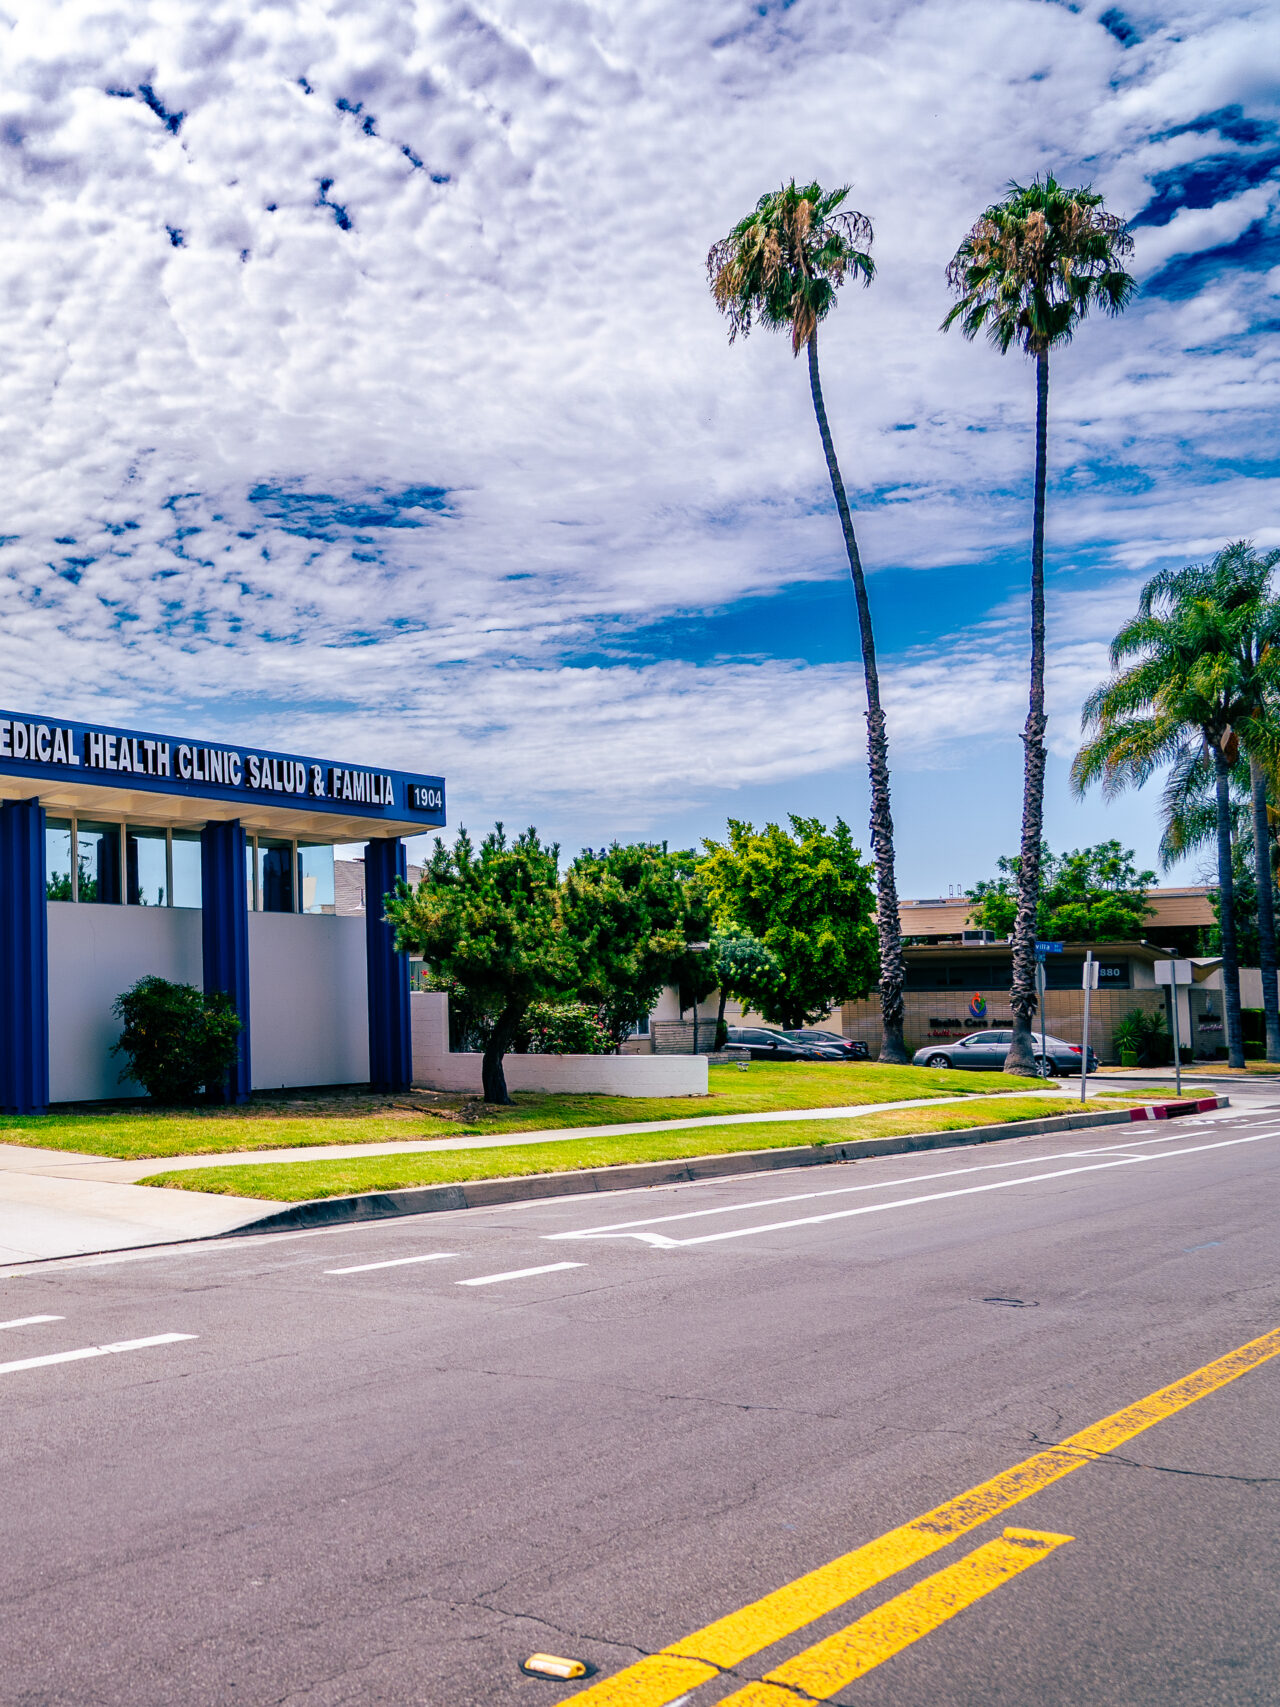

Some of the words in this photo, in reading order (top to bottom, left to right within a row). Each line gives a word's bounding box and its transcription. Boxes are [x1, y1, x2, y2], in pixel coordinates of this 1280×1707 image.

[89, 731, 170, 777] HEALTH
[178, 743, 241, 787] CLINIC
[248, 754, 306, 794] SALUD
[313, 764, 325, 797] &
[332, 767, 395, 806] FAMILIA
[414, 787, 443, 809] 1904
